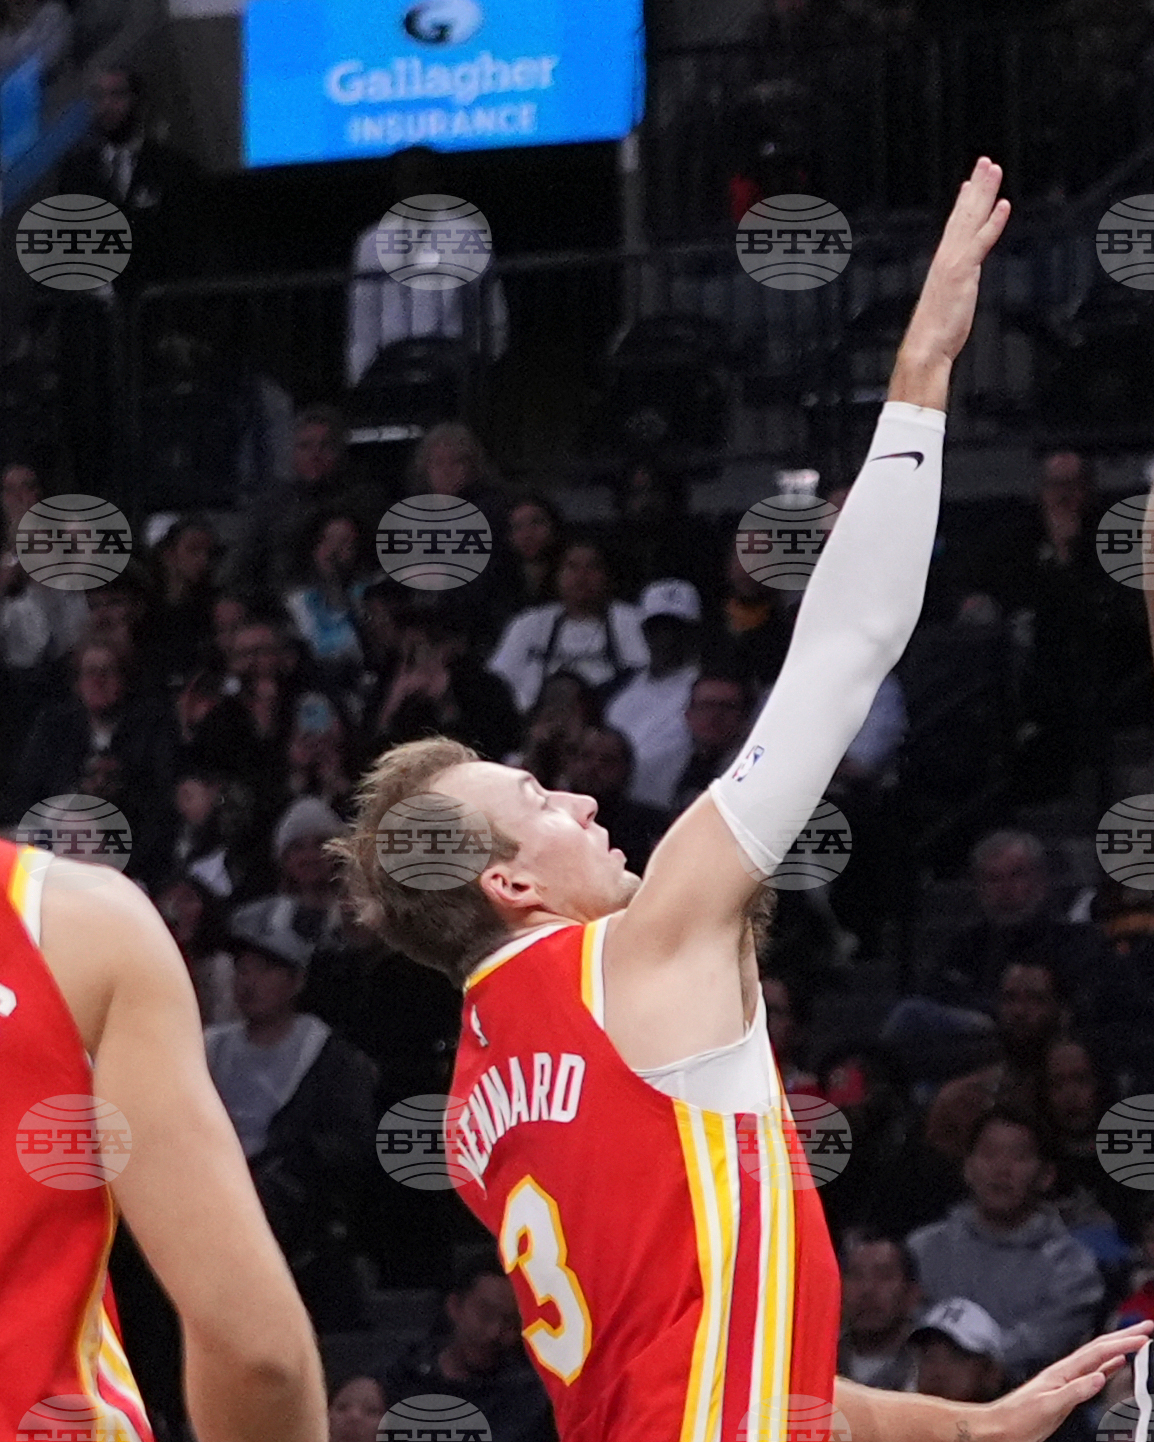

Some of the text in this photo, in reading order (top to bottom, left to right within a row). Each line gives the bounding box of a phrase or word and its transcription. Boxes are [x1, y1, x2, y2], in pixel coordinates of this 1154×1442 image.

[325, 51, 558, 105] Gallagher
[347, 102, 536, 143] INSURANCE
[500, 1174, 593, 1386] 3
